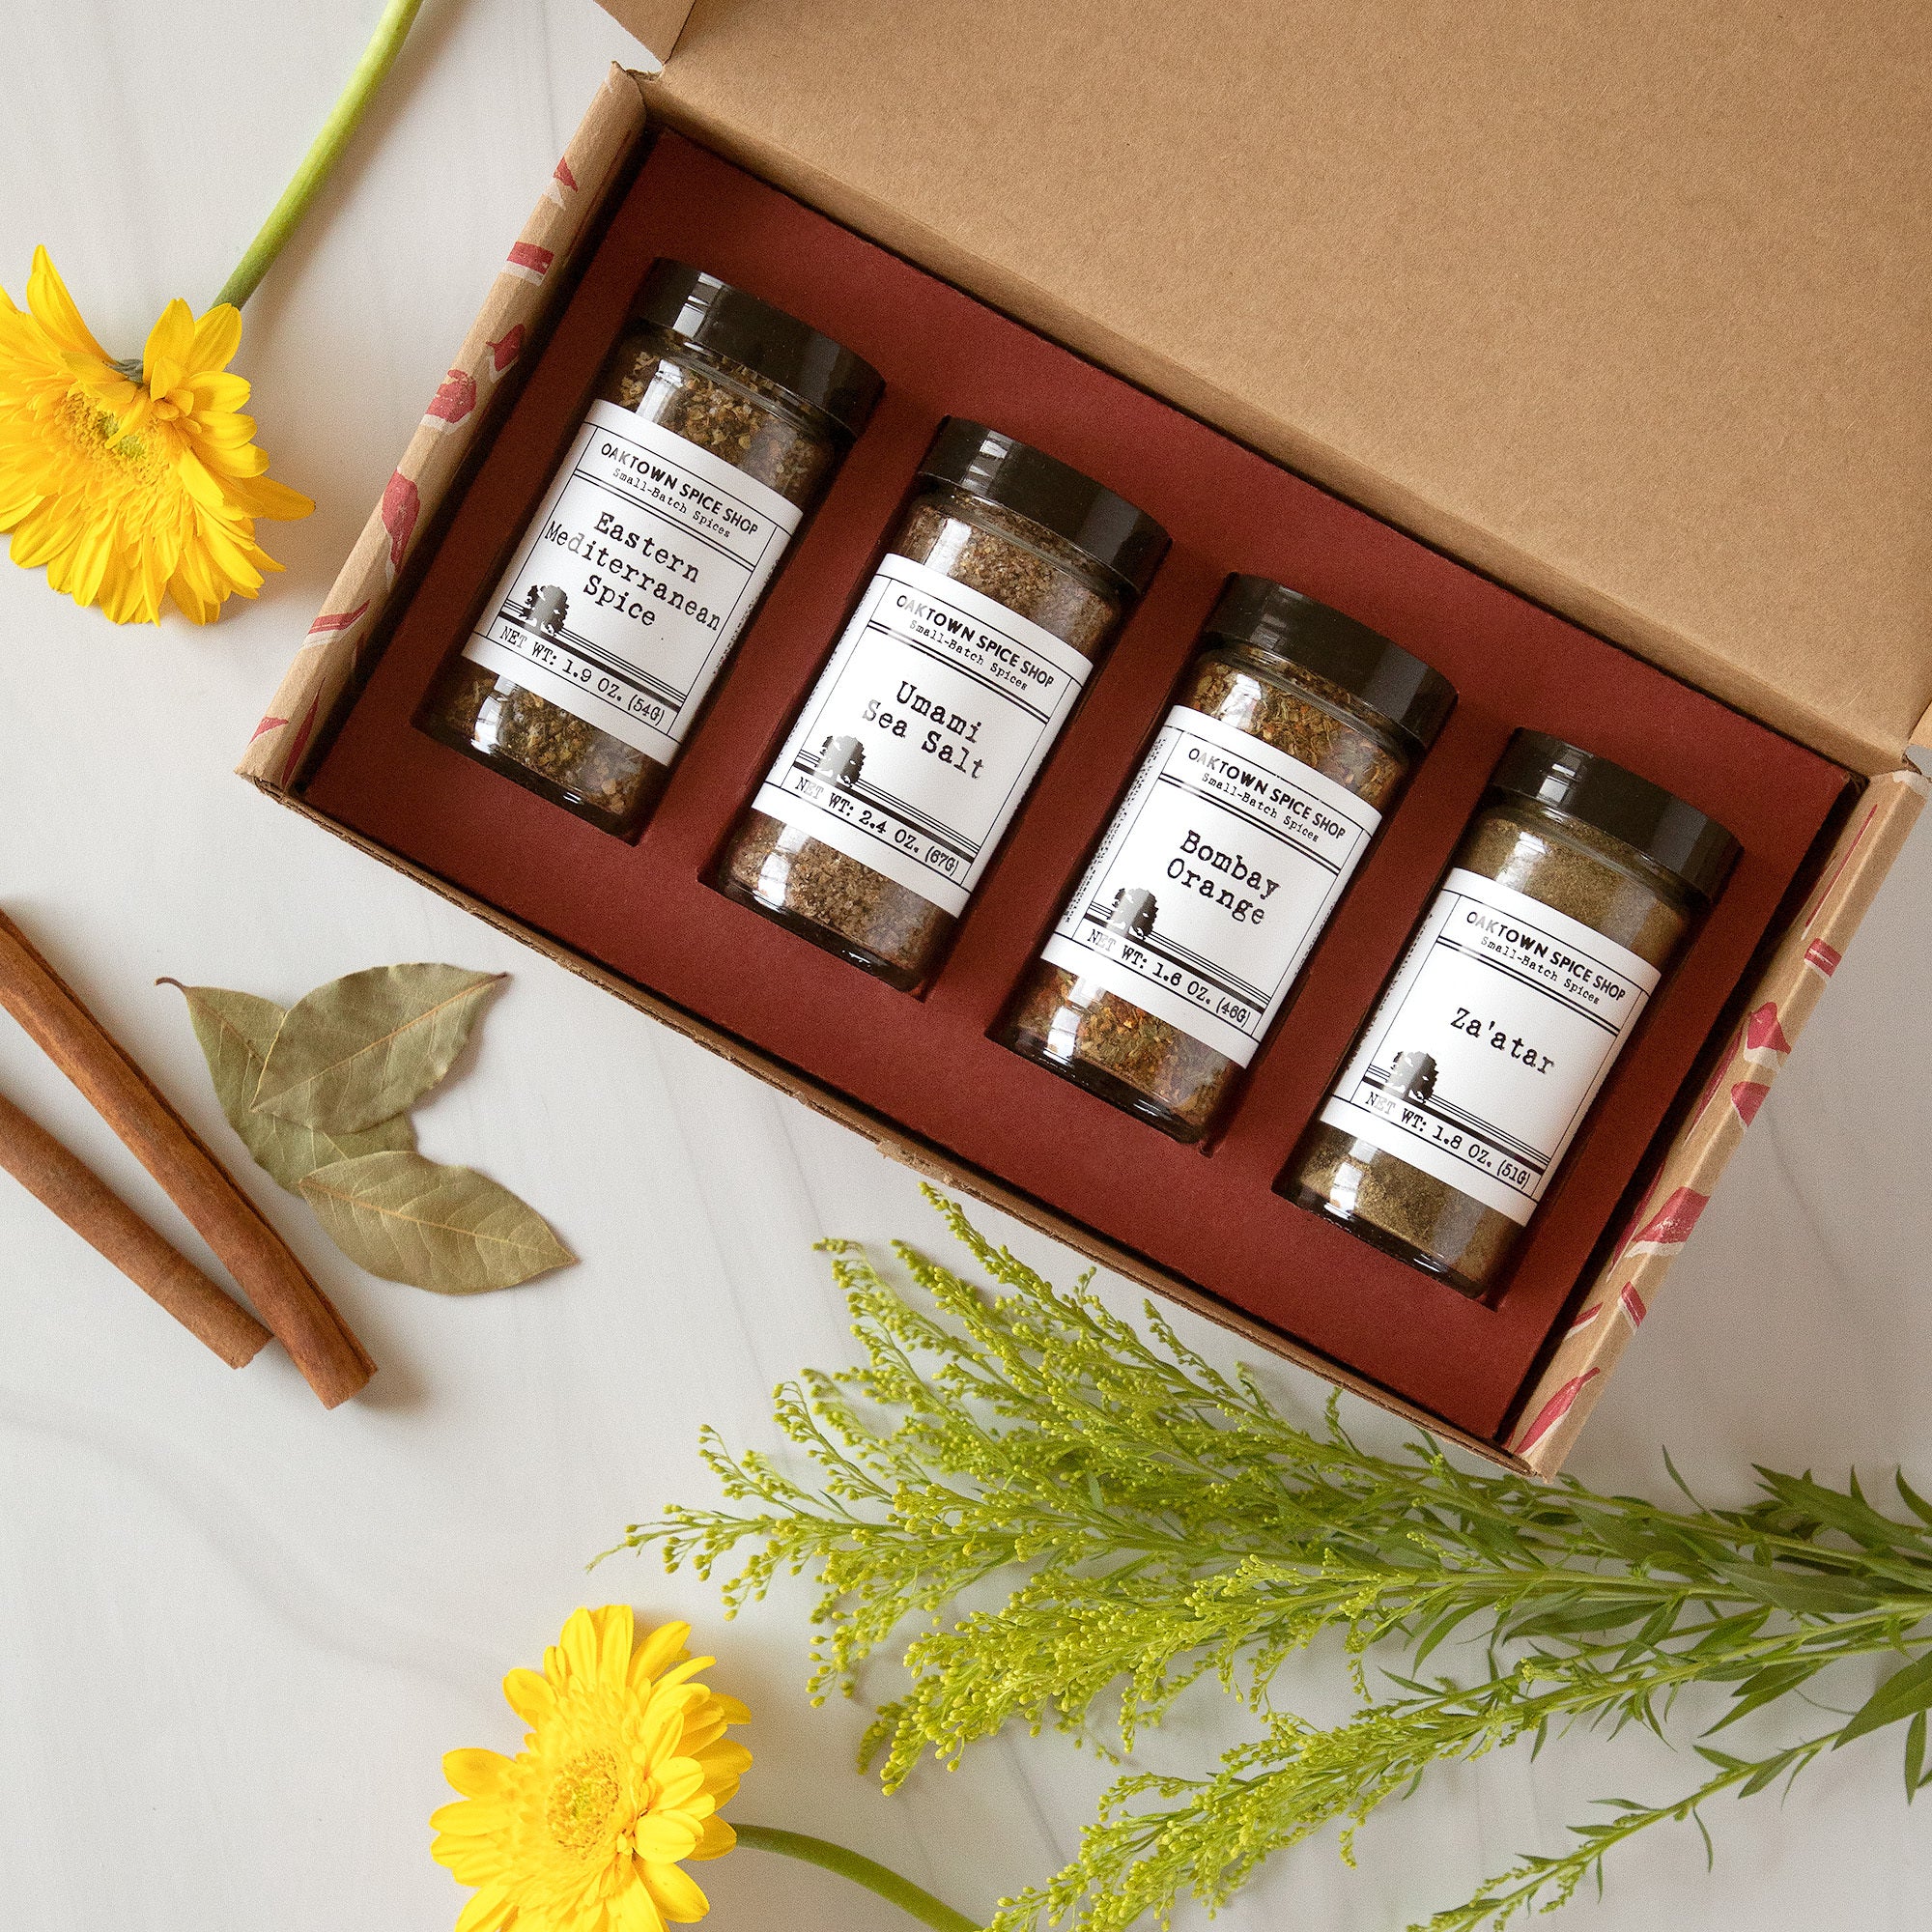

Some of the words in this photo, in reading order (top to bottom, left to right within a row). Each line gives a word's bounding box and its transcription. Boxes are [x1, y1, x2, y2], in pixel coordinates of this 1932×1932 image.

[601, 442, 677, 490] OAKTOWN
[679, 483, 721, 516] SPICE
[722, 508, 758, 534] SHOP
[613, 468, 688, 518] Small-Batch
[693, 510, 730, 538] Spices
[544, 521, 721, 631] Mediterranean
[594, 512, 699, 582] Eastern
[583, 576, 656, 627] Spice
[499, 627, 527, 649] NET
[532, 642, 557, 666] WT:
[562, 660, 591, 683] 1.9
[597, 678, 622, 700] OZ.
[628, 695, 665, 724] (54G)
[896, 595, 975, 642] OAKTOWN
[976, 636, 1018, 667] SPICE
[1020, 660, 1054, 687] SHOP
[909, 619, 984, 666] Small-Batch
[990, 662, 1028, 690] Spices
[863, 699, 906, 737] Sea
[922, 731, 985, 781] Salt
[895, 681, 982, 744] Umami
[795, 778, 824, 803] NET
[828, 793, 854, 816] WT:
[858, 810, 887, 833] 2.4
[895, 829, 919, 852] OZ.
[925, 844, 959, 876] (67G)
[1188, 748, 1268, 793] OAKTOWN
[1269, 787, 1312, 819] SPICE
[1314, 812, 1346, 838] SHOP
[1201, 773, 1278, 818] Small-Batch
[1283, 815, 1319, 843] Spices
[1166, 859, 1265, 925] Orange
[1179, 830, 1281, 899] Bombay
[1087, 929, 1116, 952] NET
[1121, 945, 1147, 969] WT:
[1187, 980, 1211, 1004] OZ.
[1466, 911, 1548, 958] OAKTOWN
[1549, 951, 1592, 982] SPICE
[1593, 975, 1626, 1003] SHOP
[1480, 935, 1558, 981] Small-Batch
[1563, 978, 1600, 1005] Spices
[1450, 1007, 1554, 1075] Za'atar
[1366, 1094, 1395, 1115] NET
[1401, 1108, 1428, 1132] WT:
[1432, 1125, 1463, 1149] 1.8
[1468, 1143, 1492, 1167] OZ.
[1496, 1159, 1531, 1188] (51G)
